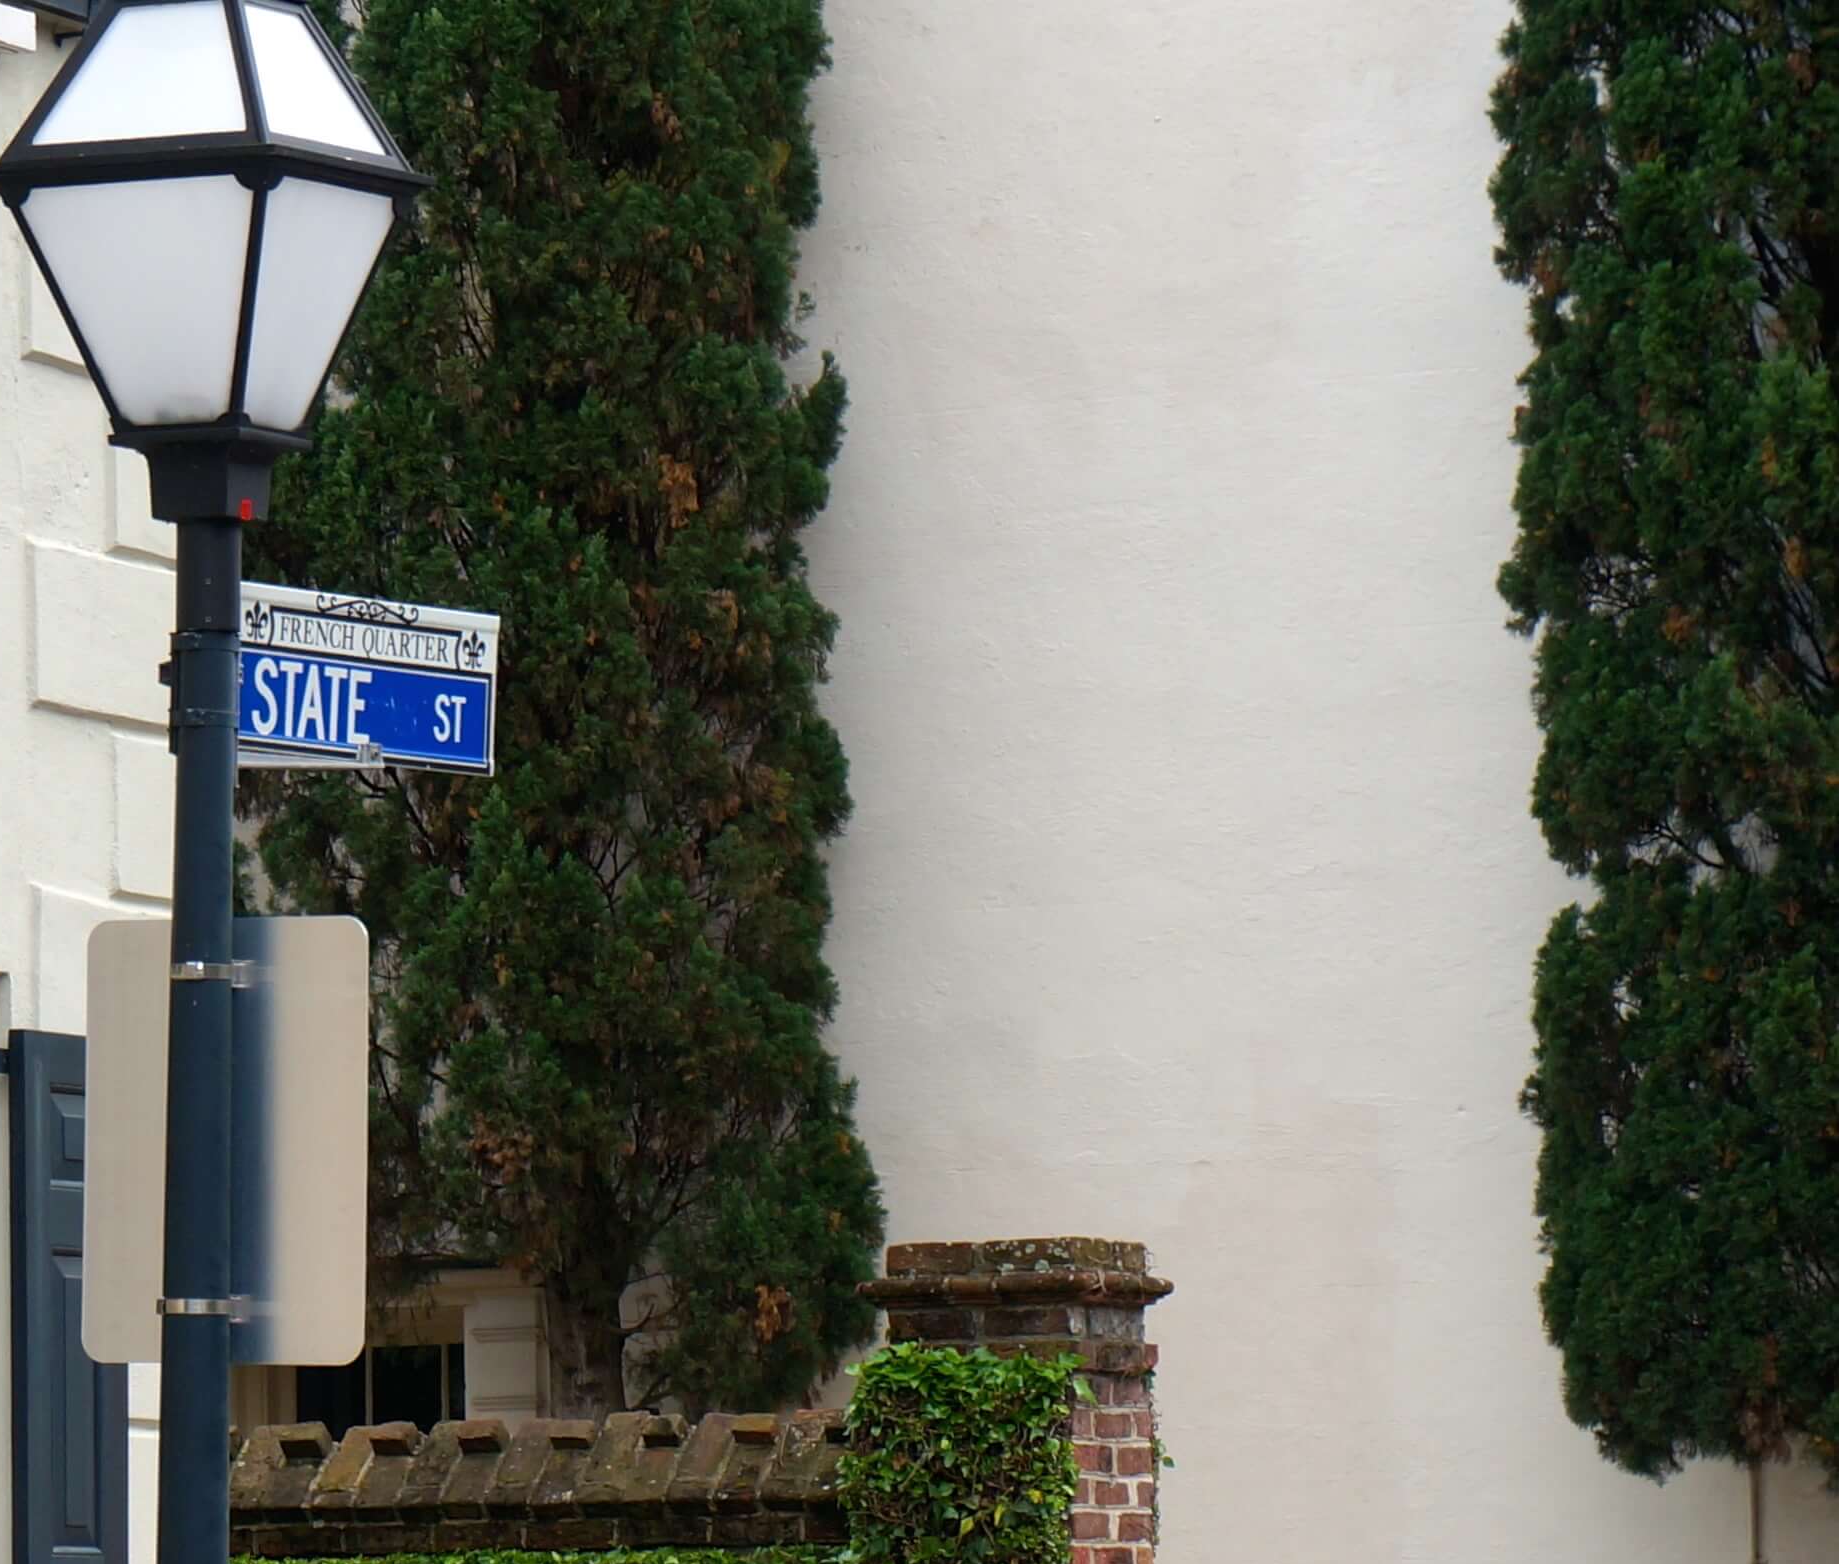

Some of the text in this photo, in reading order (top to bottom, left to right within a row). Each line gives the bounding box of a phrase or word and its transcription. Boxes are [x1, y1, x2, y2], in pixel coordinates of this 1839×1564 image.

[279, 615, 449, 664] FRENCH QUARTER
[251, 657, 467, 744] STATE ST
